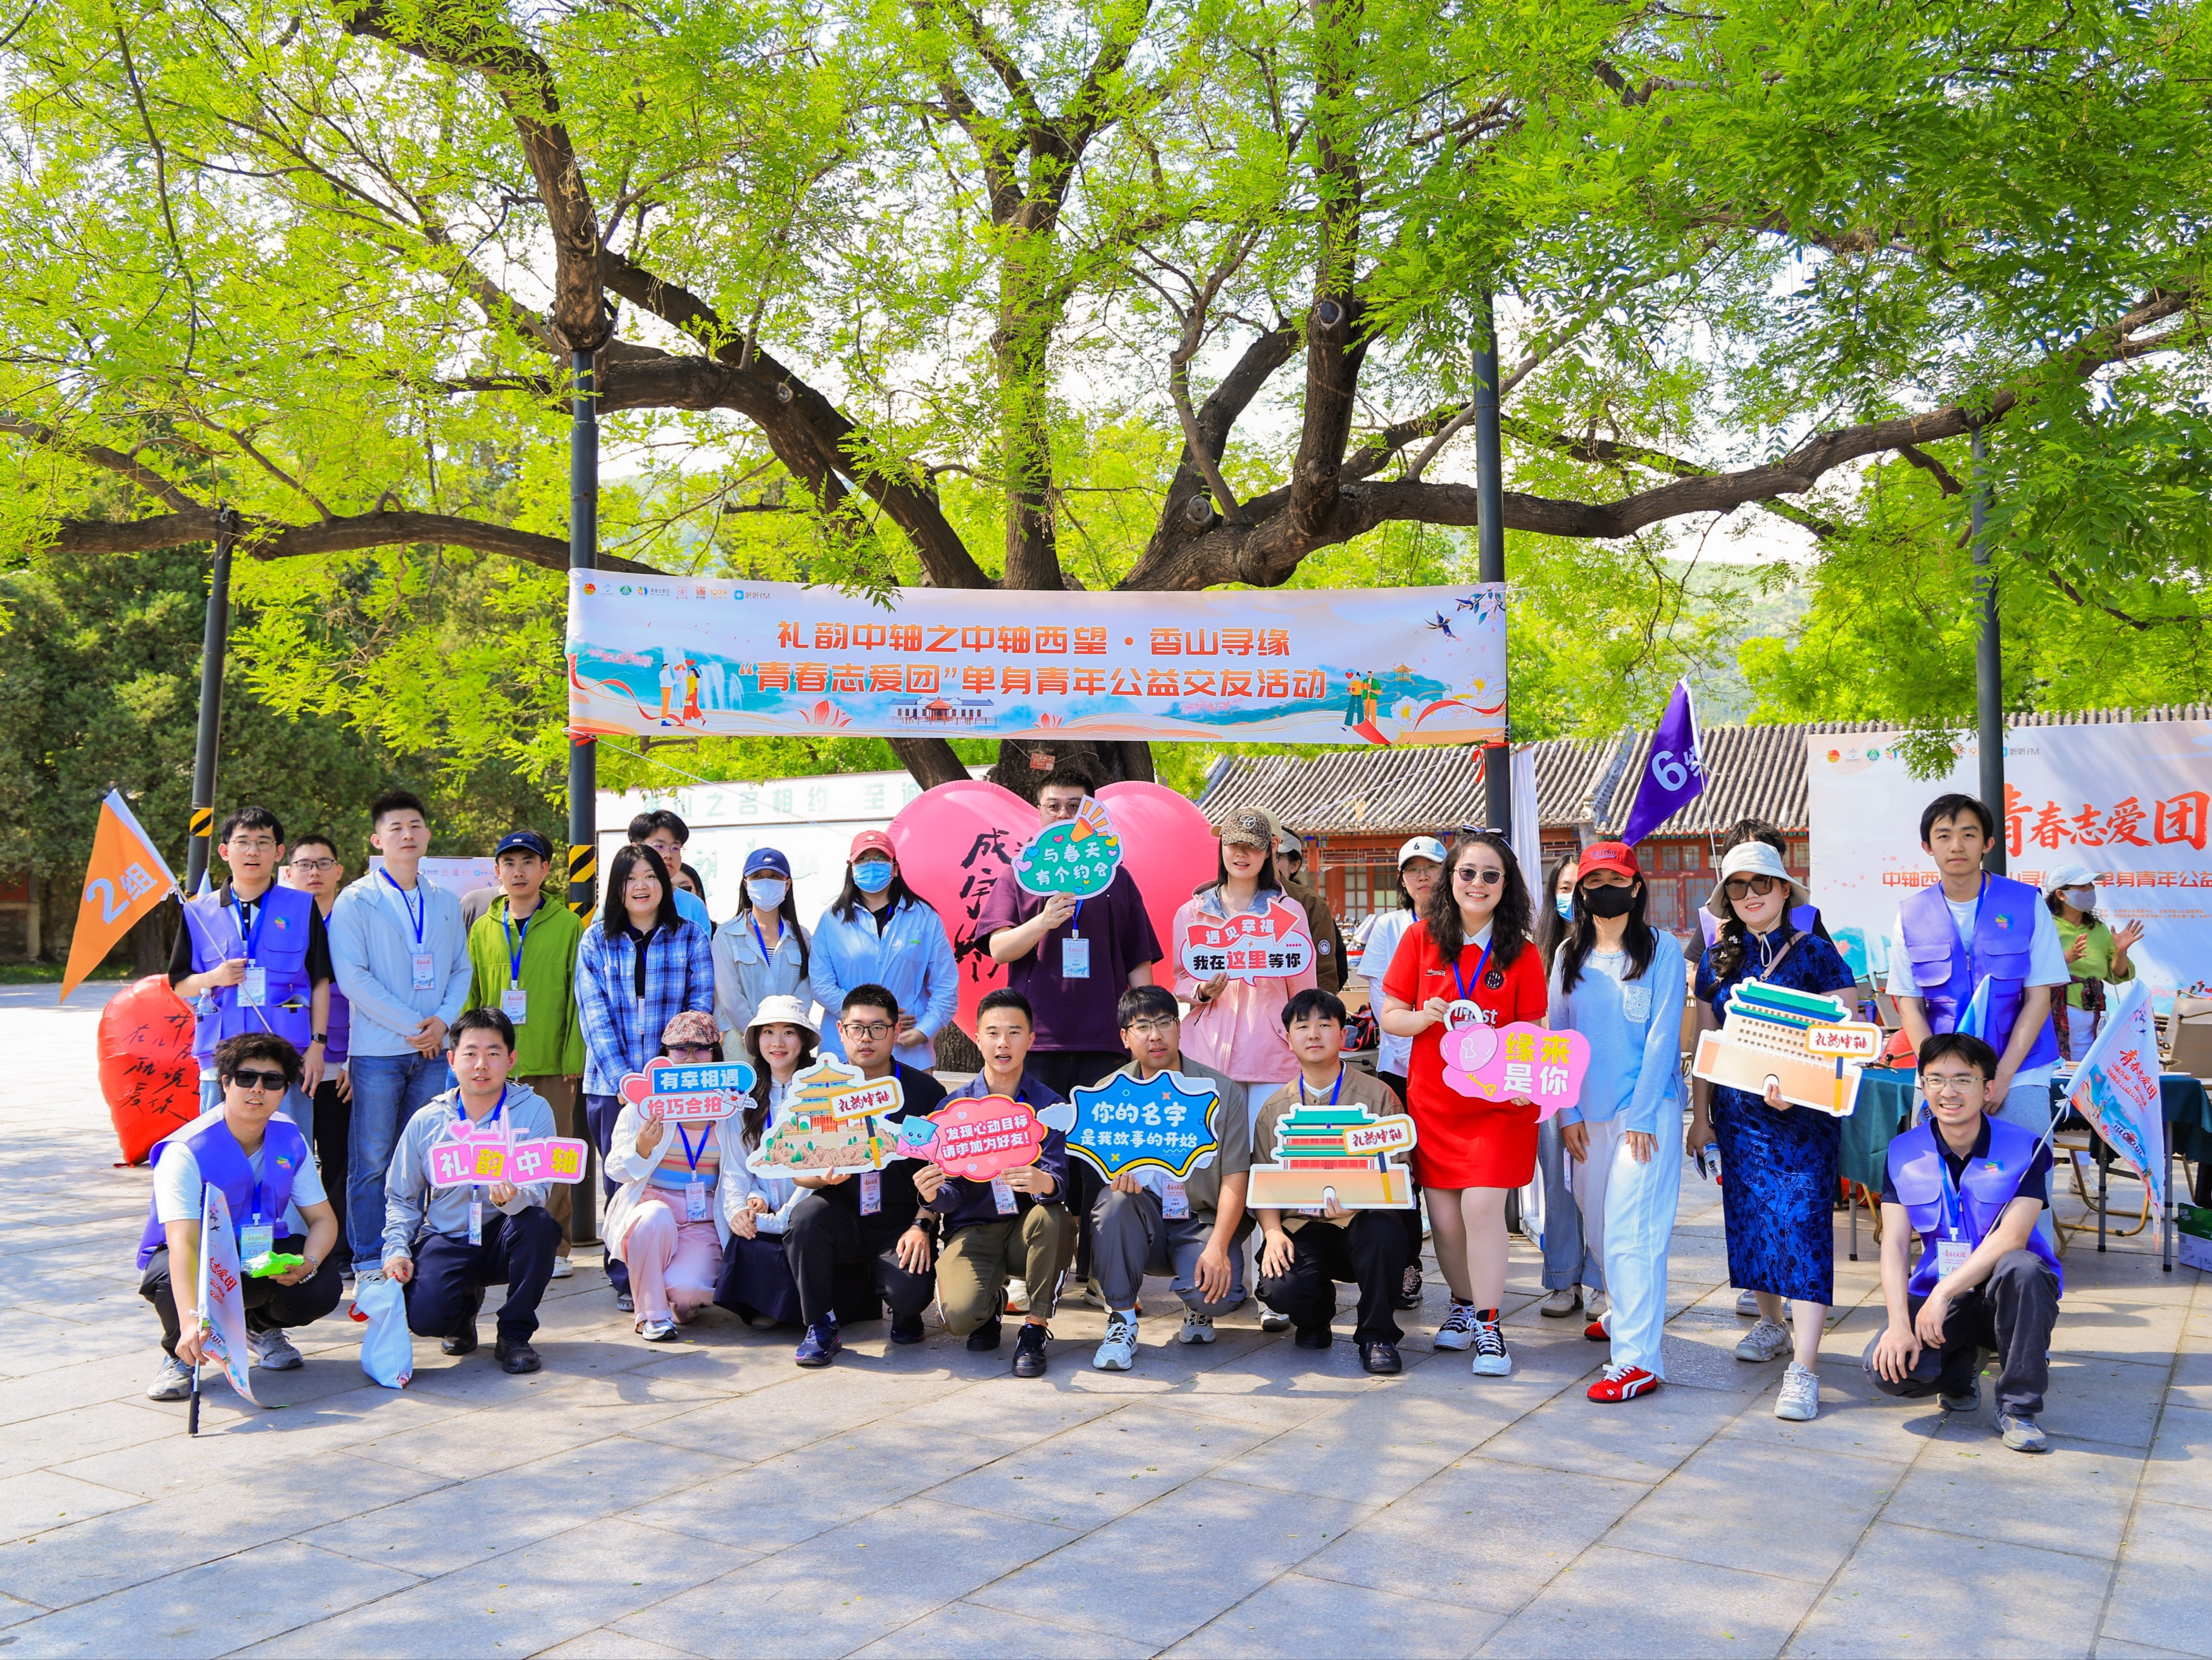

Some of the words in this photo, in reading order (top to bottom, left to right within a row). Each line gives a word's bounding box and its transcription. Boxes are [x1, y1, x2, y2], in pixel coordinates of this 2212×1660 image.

[1044, 840, 1101, 863] 与春天
[1036, 861, 1109, 886] 有个约会
[85, 862, 158, 925] 2组
[1205, 918, 1274, 945] 遇见幸福
[1193, 950, 1302, 971] 我在这里等你
[1505, 1032, 1571, 1064] 缘来
[1816, 1032, 1867, 1050] 礼韵中轴
[660, 1068, 739, 1090] 有幸相遇
[1503, 1064, 1570, 1095] 是你
[647, 1096, 721, 1116] 恰巧合拍
[838, 1090, 890, 1112] 礼韵中轴
[1091, 1101, 1187, 1127] 你的名字
[945, 1114, 1028, 1142] 发现心动目标
[1079, 1128, 1198, 1149] 是我故事的开始
[1352, 1129, 1403, 1147] 礼韵中轴
[440, 1146, 578, 1177] 礼韵中轴
